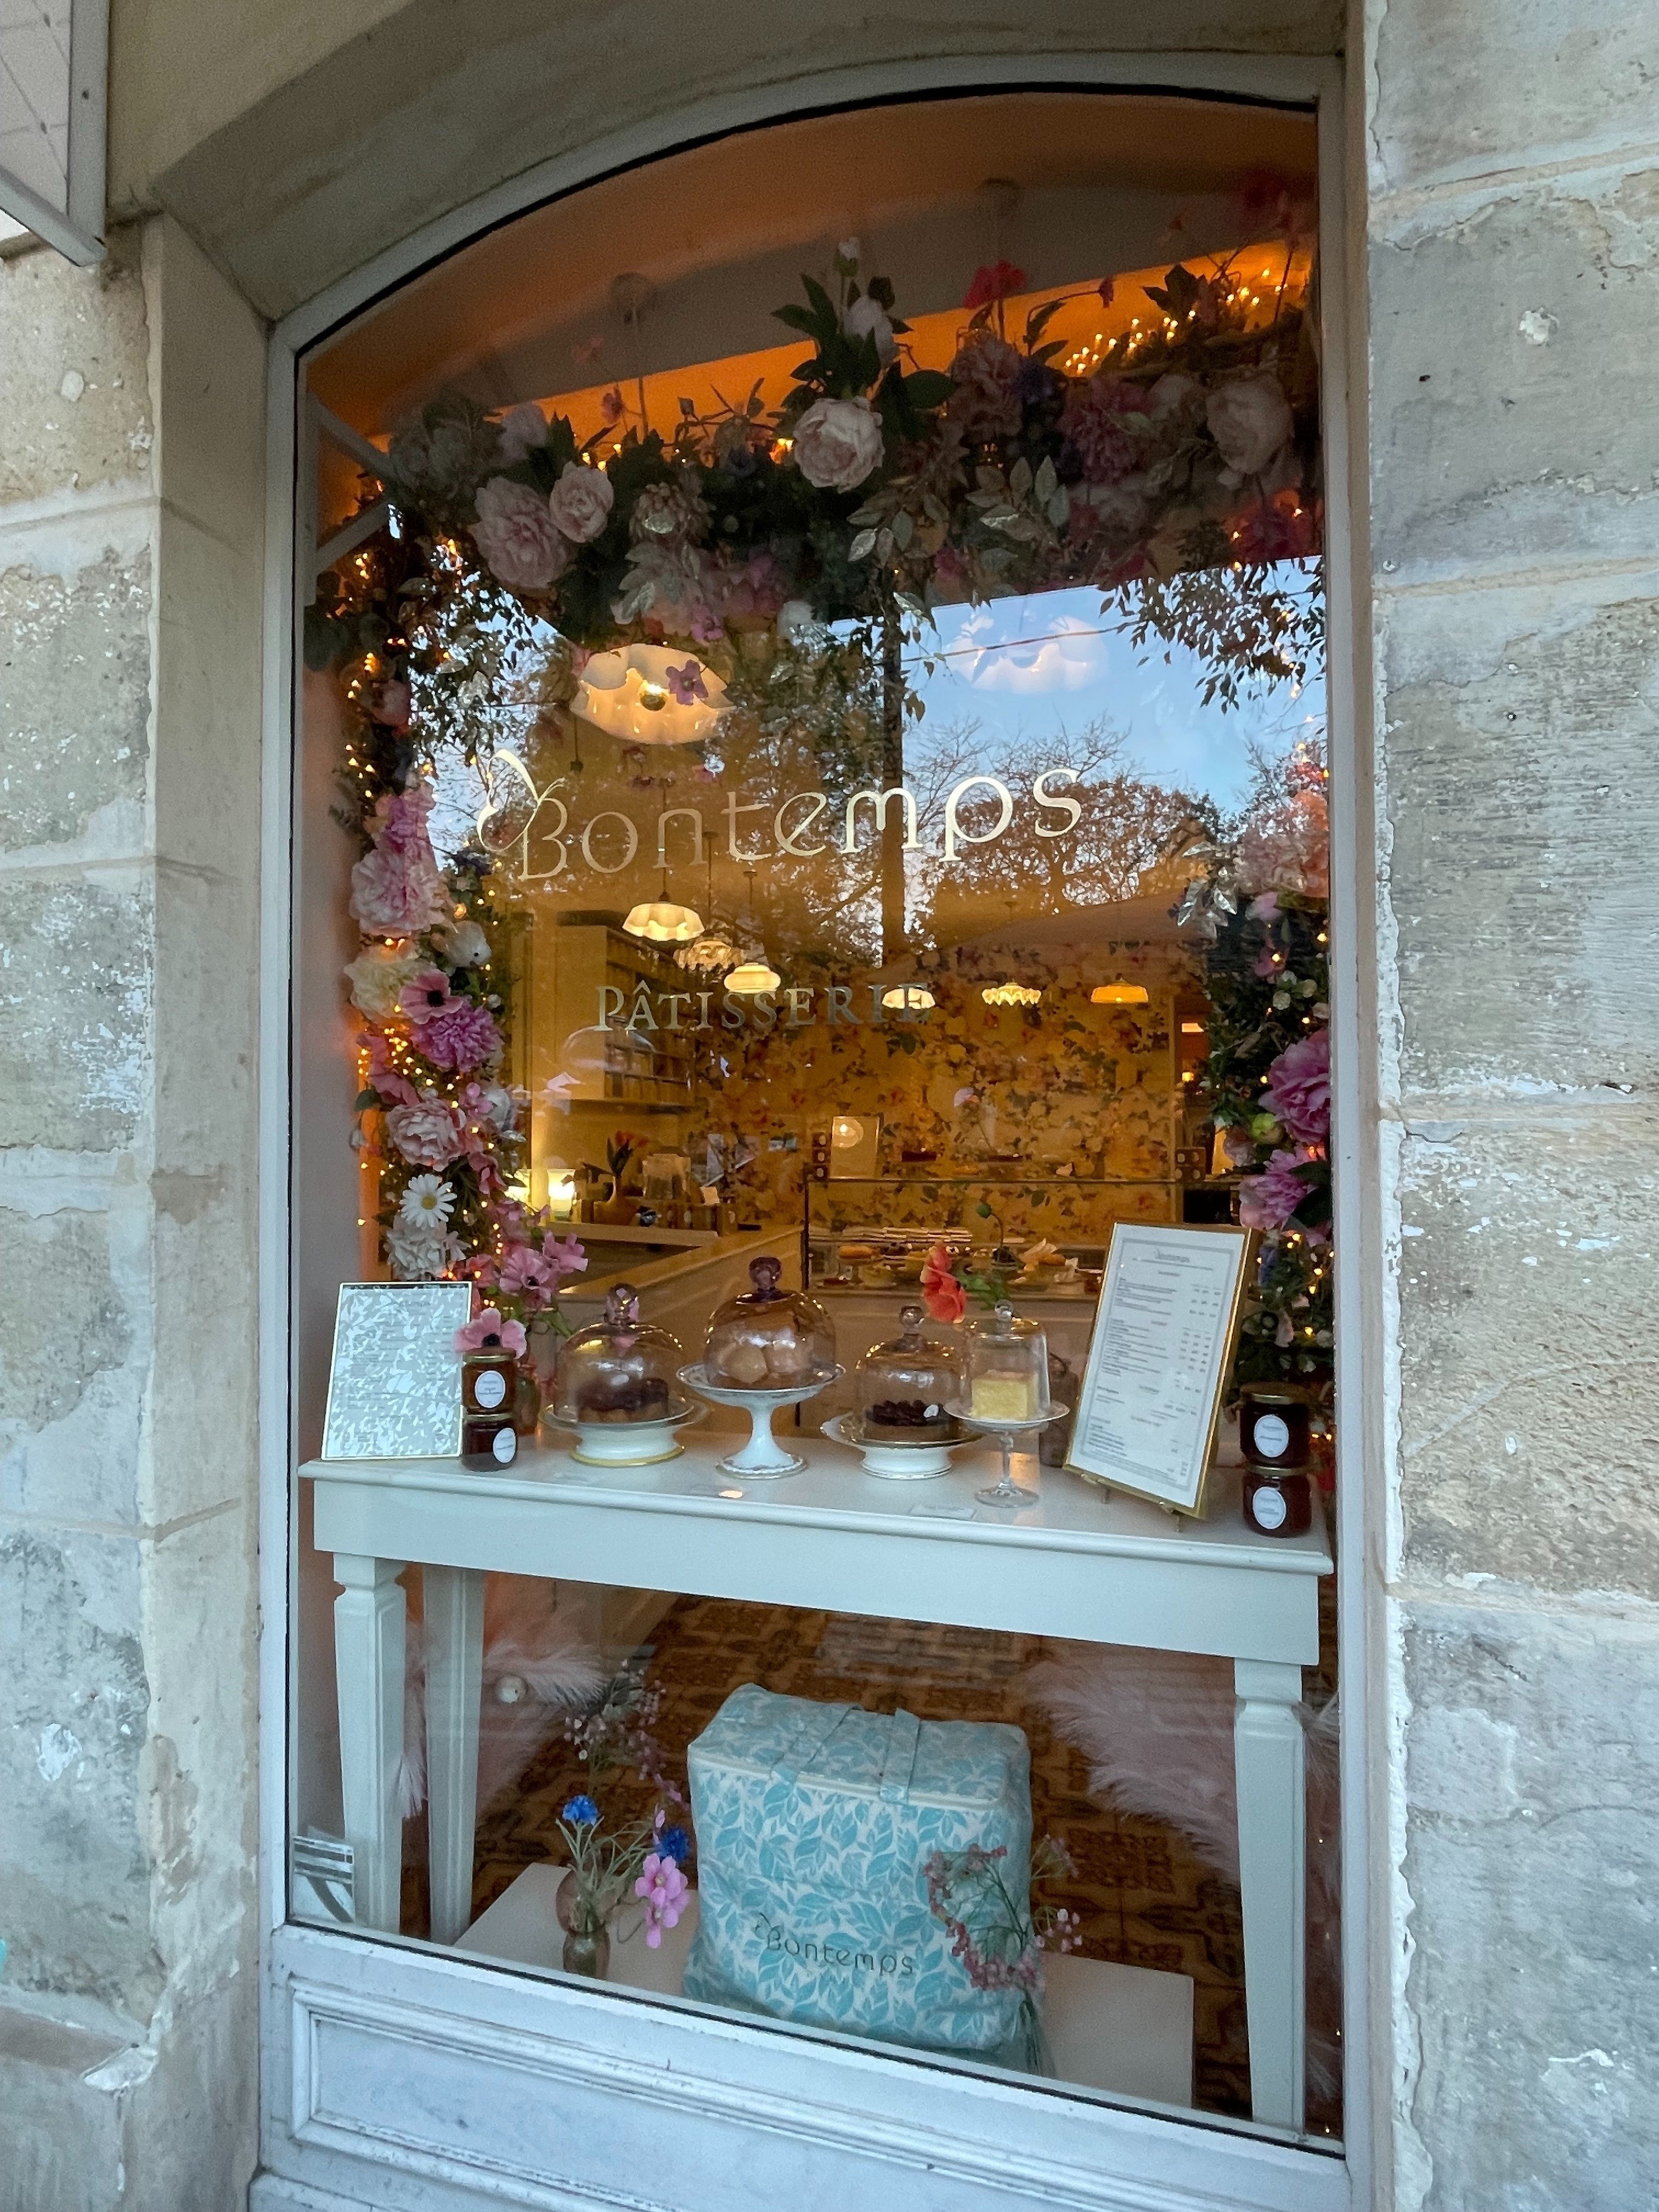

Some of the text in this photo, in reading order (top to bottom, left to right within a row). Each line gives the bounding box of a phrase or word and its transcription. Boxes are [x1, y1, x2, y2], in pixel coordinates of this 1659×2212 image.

[517, 768, 1082, 880] Bontemps
[594, 979, 930, 1031] PÂTISSERIE
[767, 1925, 915, 1976] Bontemps
